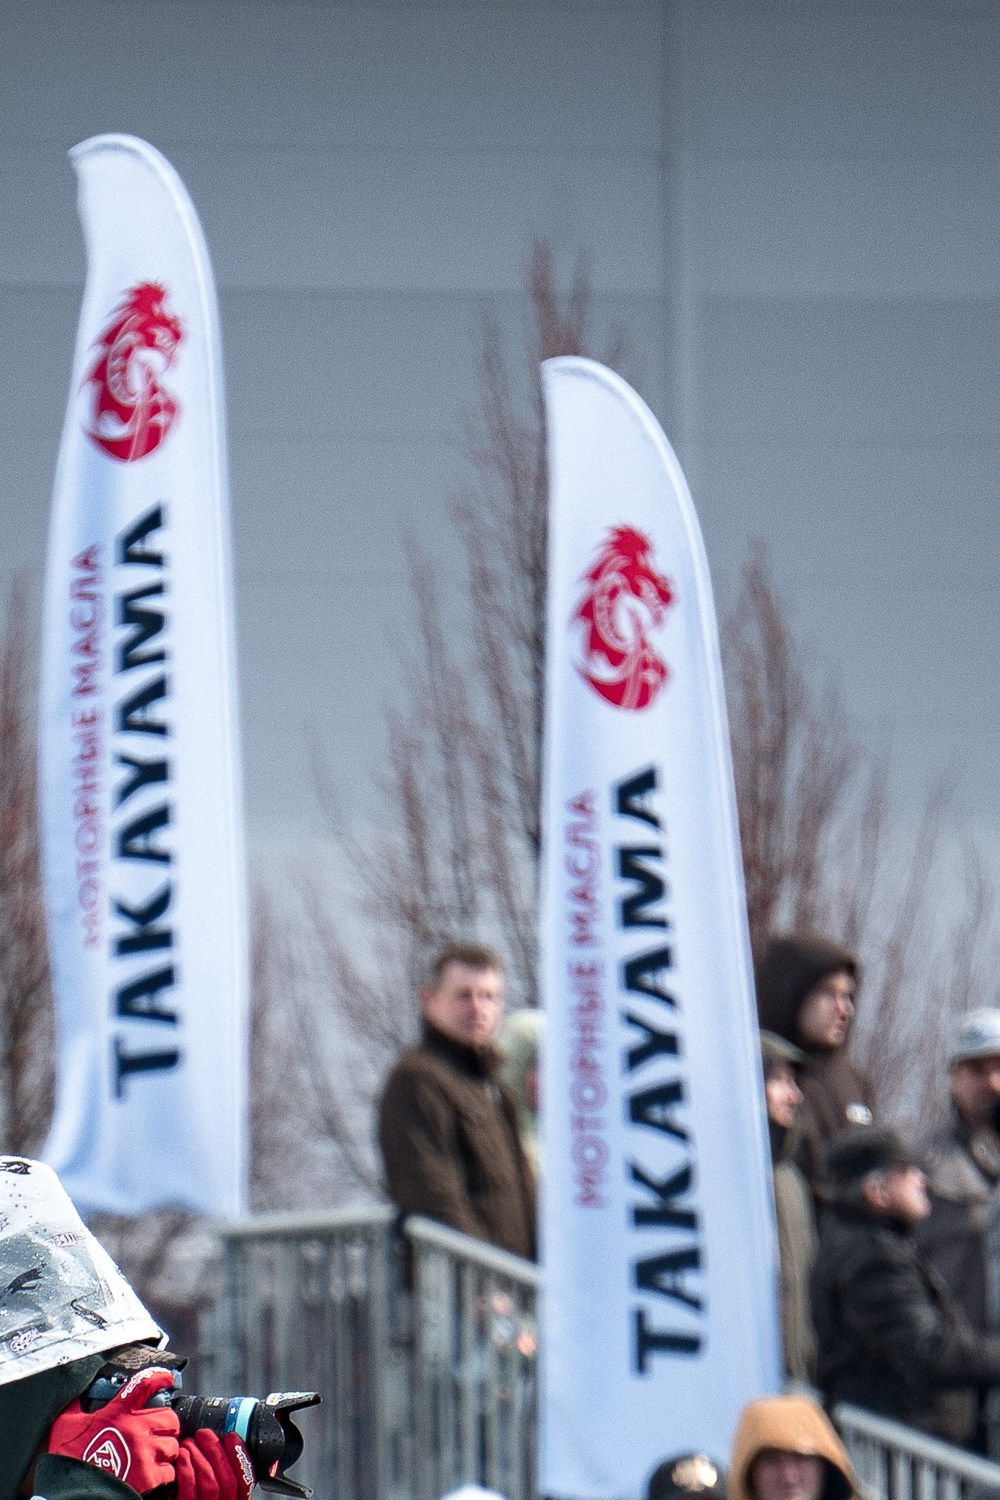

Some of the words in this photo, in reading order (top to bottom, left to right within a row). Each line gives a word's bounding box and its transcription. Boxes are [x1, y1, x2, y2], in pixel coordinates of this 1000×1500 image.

[71, 545, 99, 698] МАСЛА
[73, 708, 100, 948] МОТОРНЫЕ
[114, 502, 180, 1099] TAKAYAMA
[566, 789, 598, 947] МАСЛА
[569, 959, 606, 1208] МОТОРНЫЕ
[615, 766, 704, 1377] TAKAYAMA
